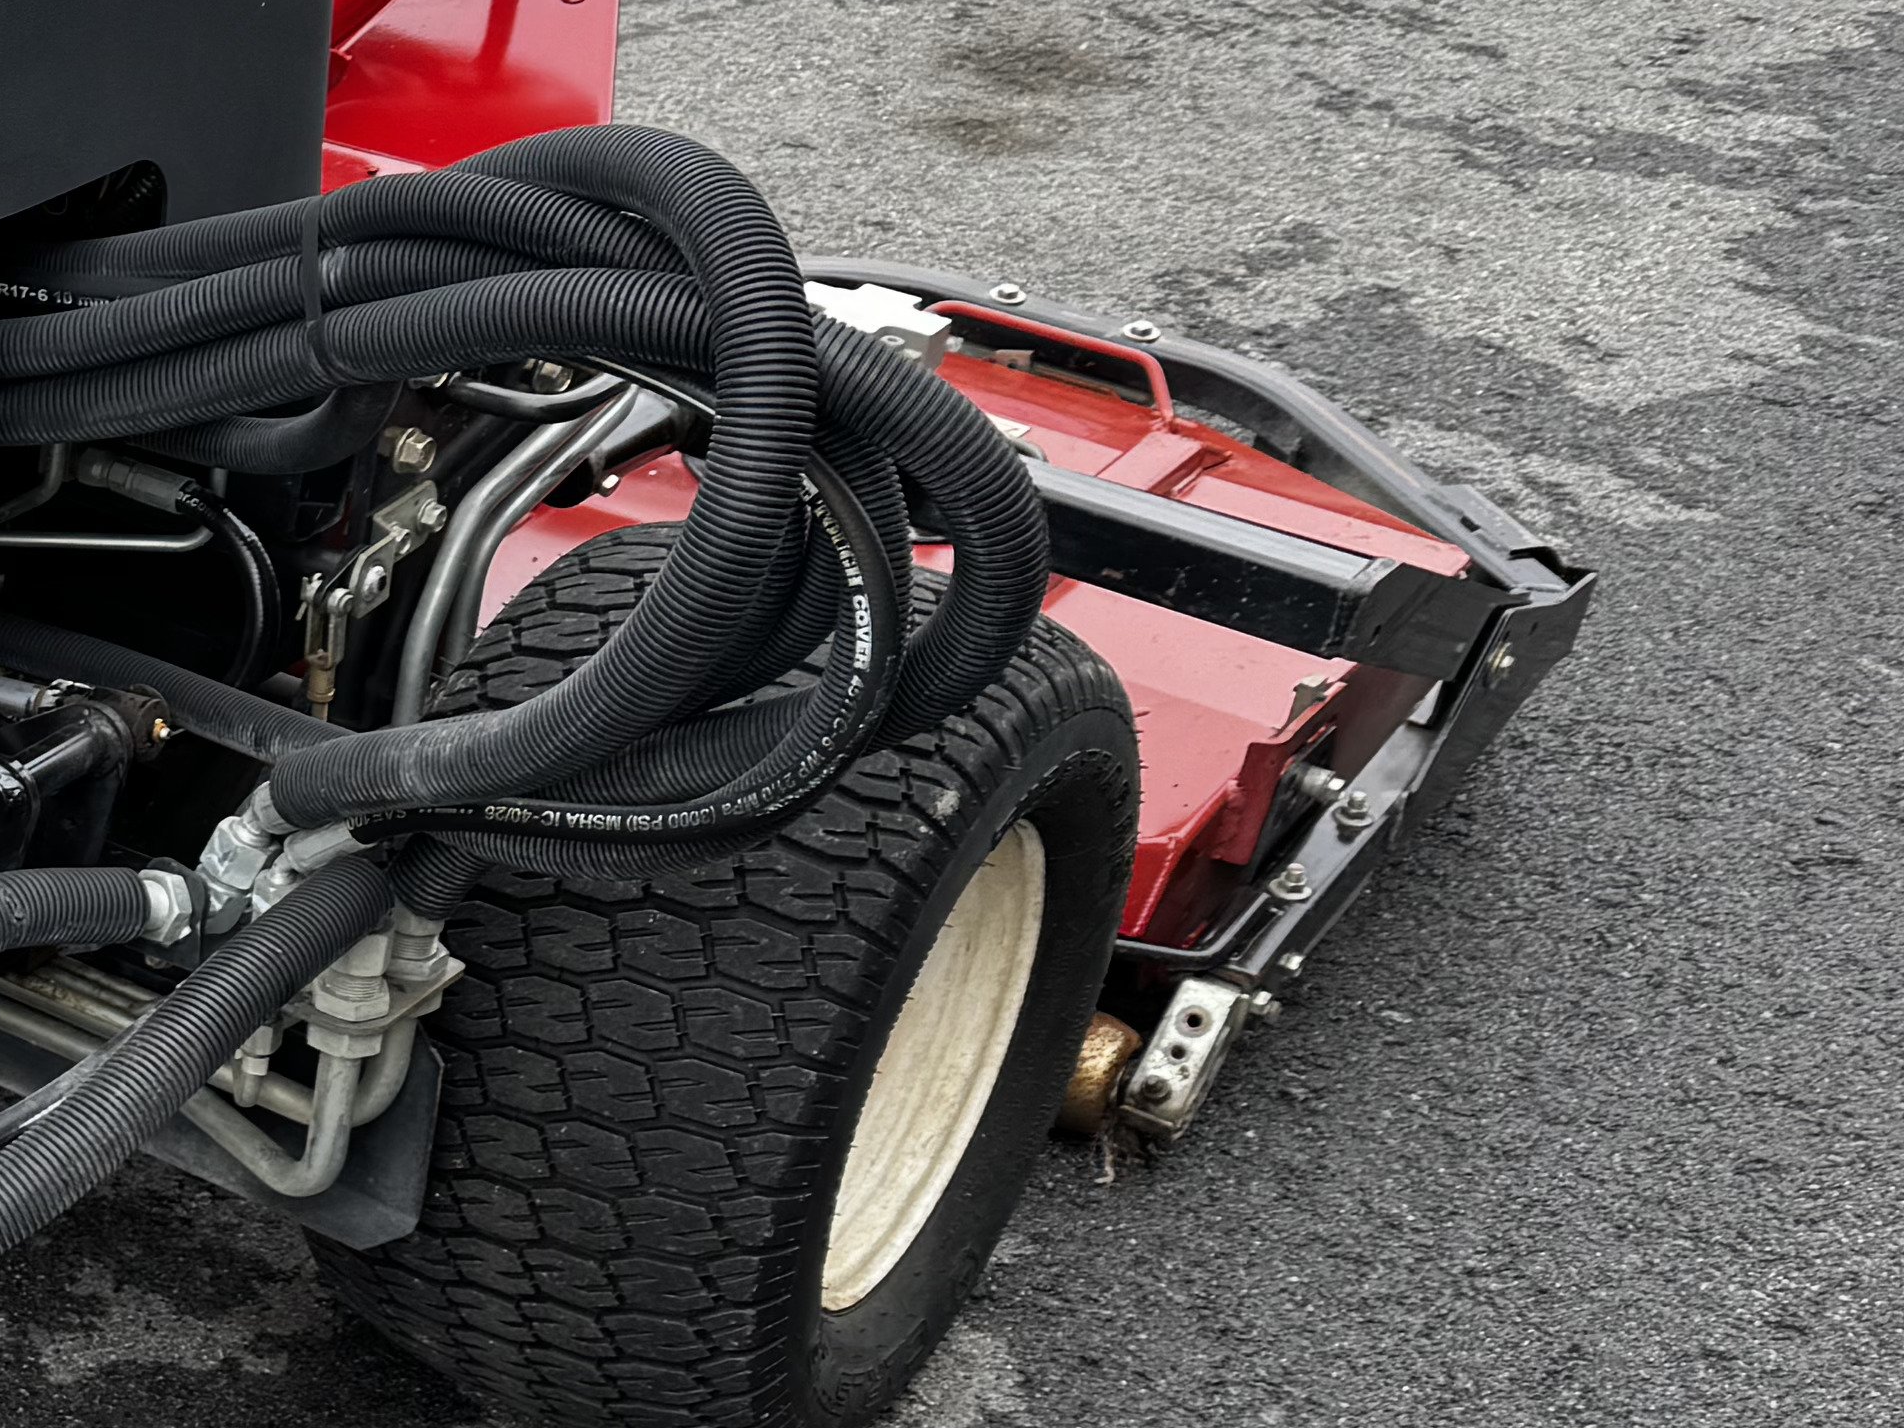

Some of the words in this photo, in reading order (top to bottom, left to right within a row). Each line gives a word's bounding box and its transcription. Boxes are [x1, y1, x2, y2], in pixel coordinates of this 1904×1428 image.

[852, 592, 873, 672] COVER
[565, 811, 622, 832] MSHA
[626, 814, 664, 832] PSI)
[668, 805, 716, 830] (3000
